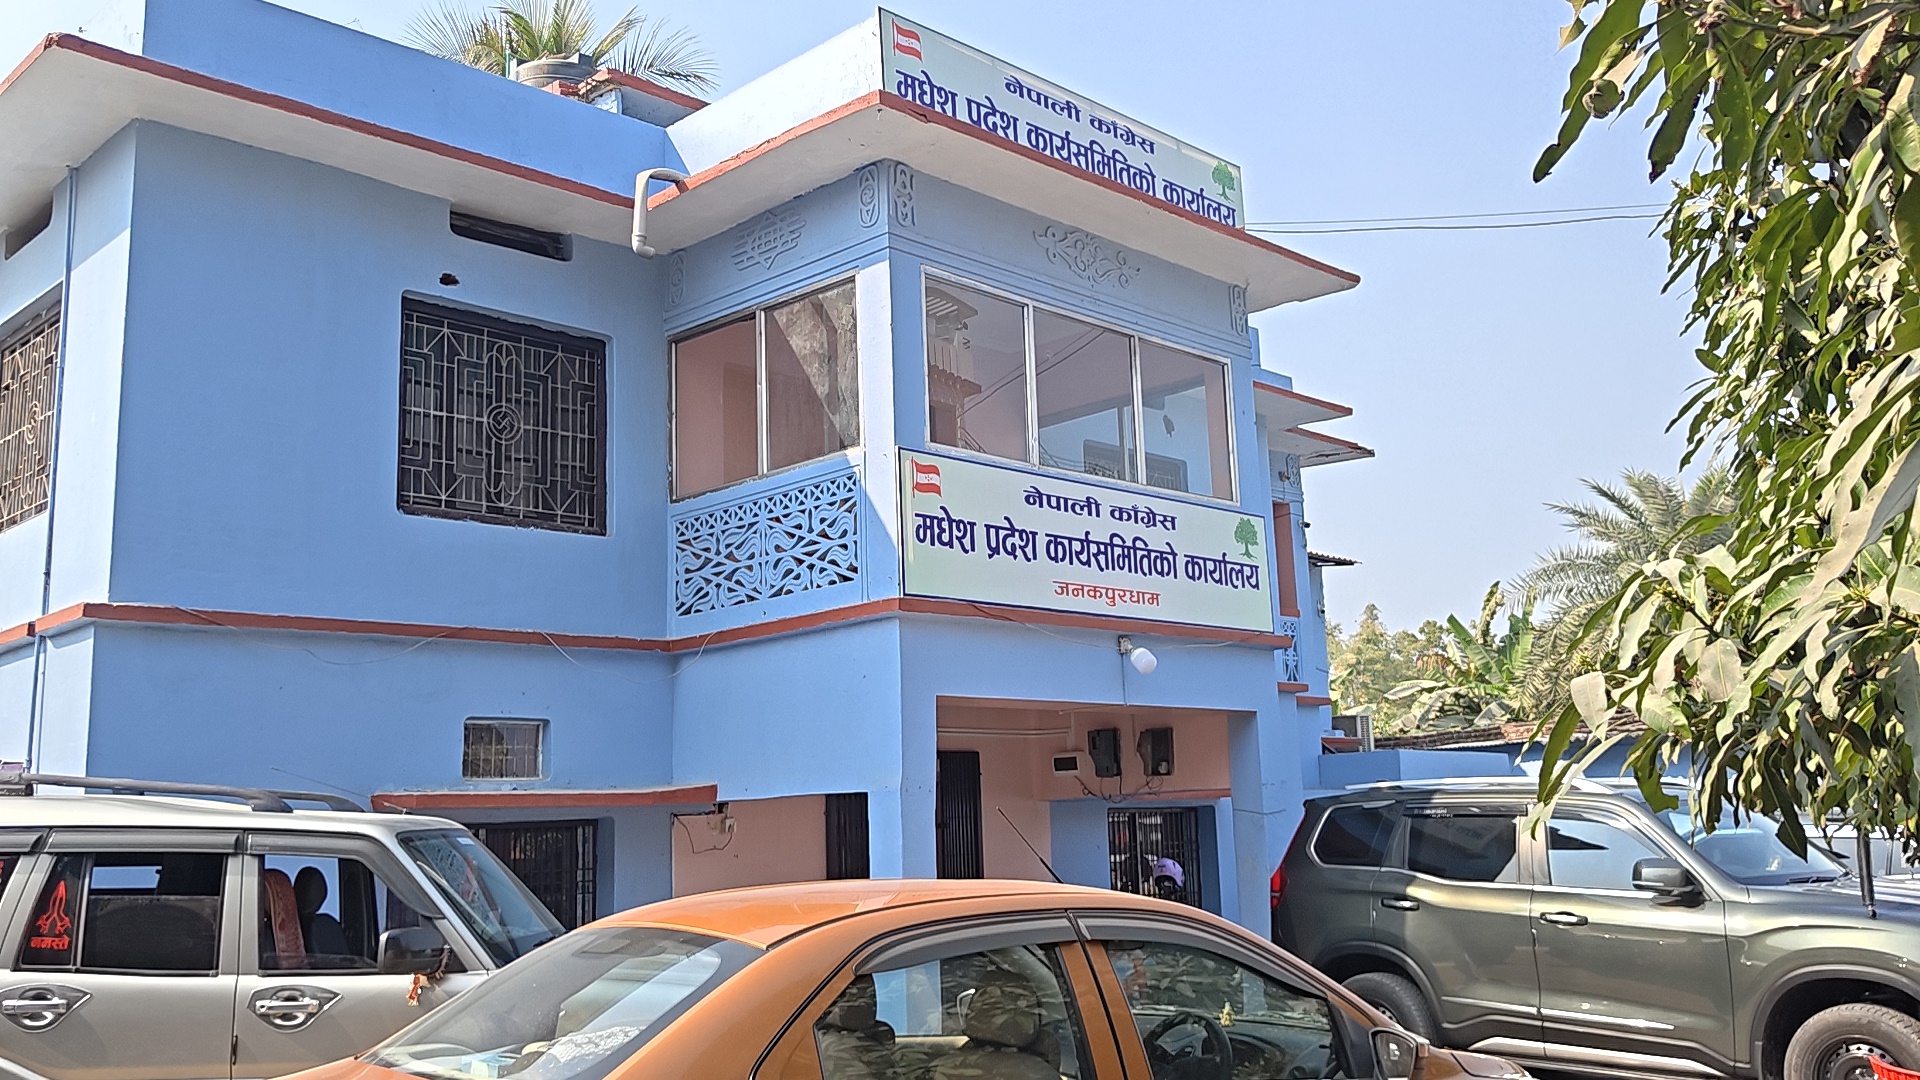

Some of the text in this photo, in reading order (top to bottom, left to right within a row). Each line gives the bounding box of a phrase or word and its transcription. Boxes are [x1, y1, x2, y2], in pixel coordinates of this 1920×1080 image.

[1004, 75, 1157, 155] नेपाली काँग्रेस
[895, 69, 959, 118] मधेश
[1026, 121, 1157, 197] कार्यसमितिको
[1161, 178, 1237, 227] कार्यालय
[1022, 485, 1178, 531] नेपाली काँग्रेस
[914, 505, 1261, 591] मधेश प्रदेश कार्यसमितिको कार्यालय
[1052, 580, 1161, 607] जनकपुरधाम
[30, 935, 71, 950] नमस्ते
